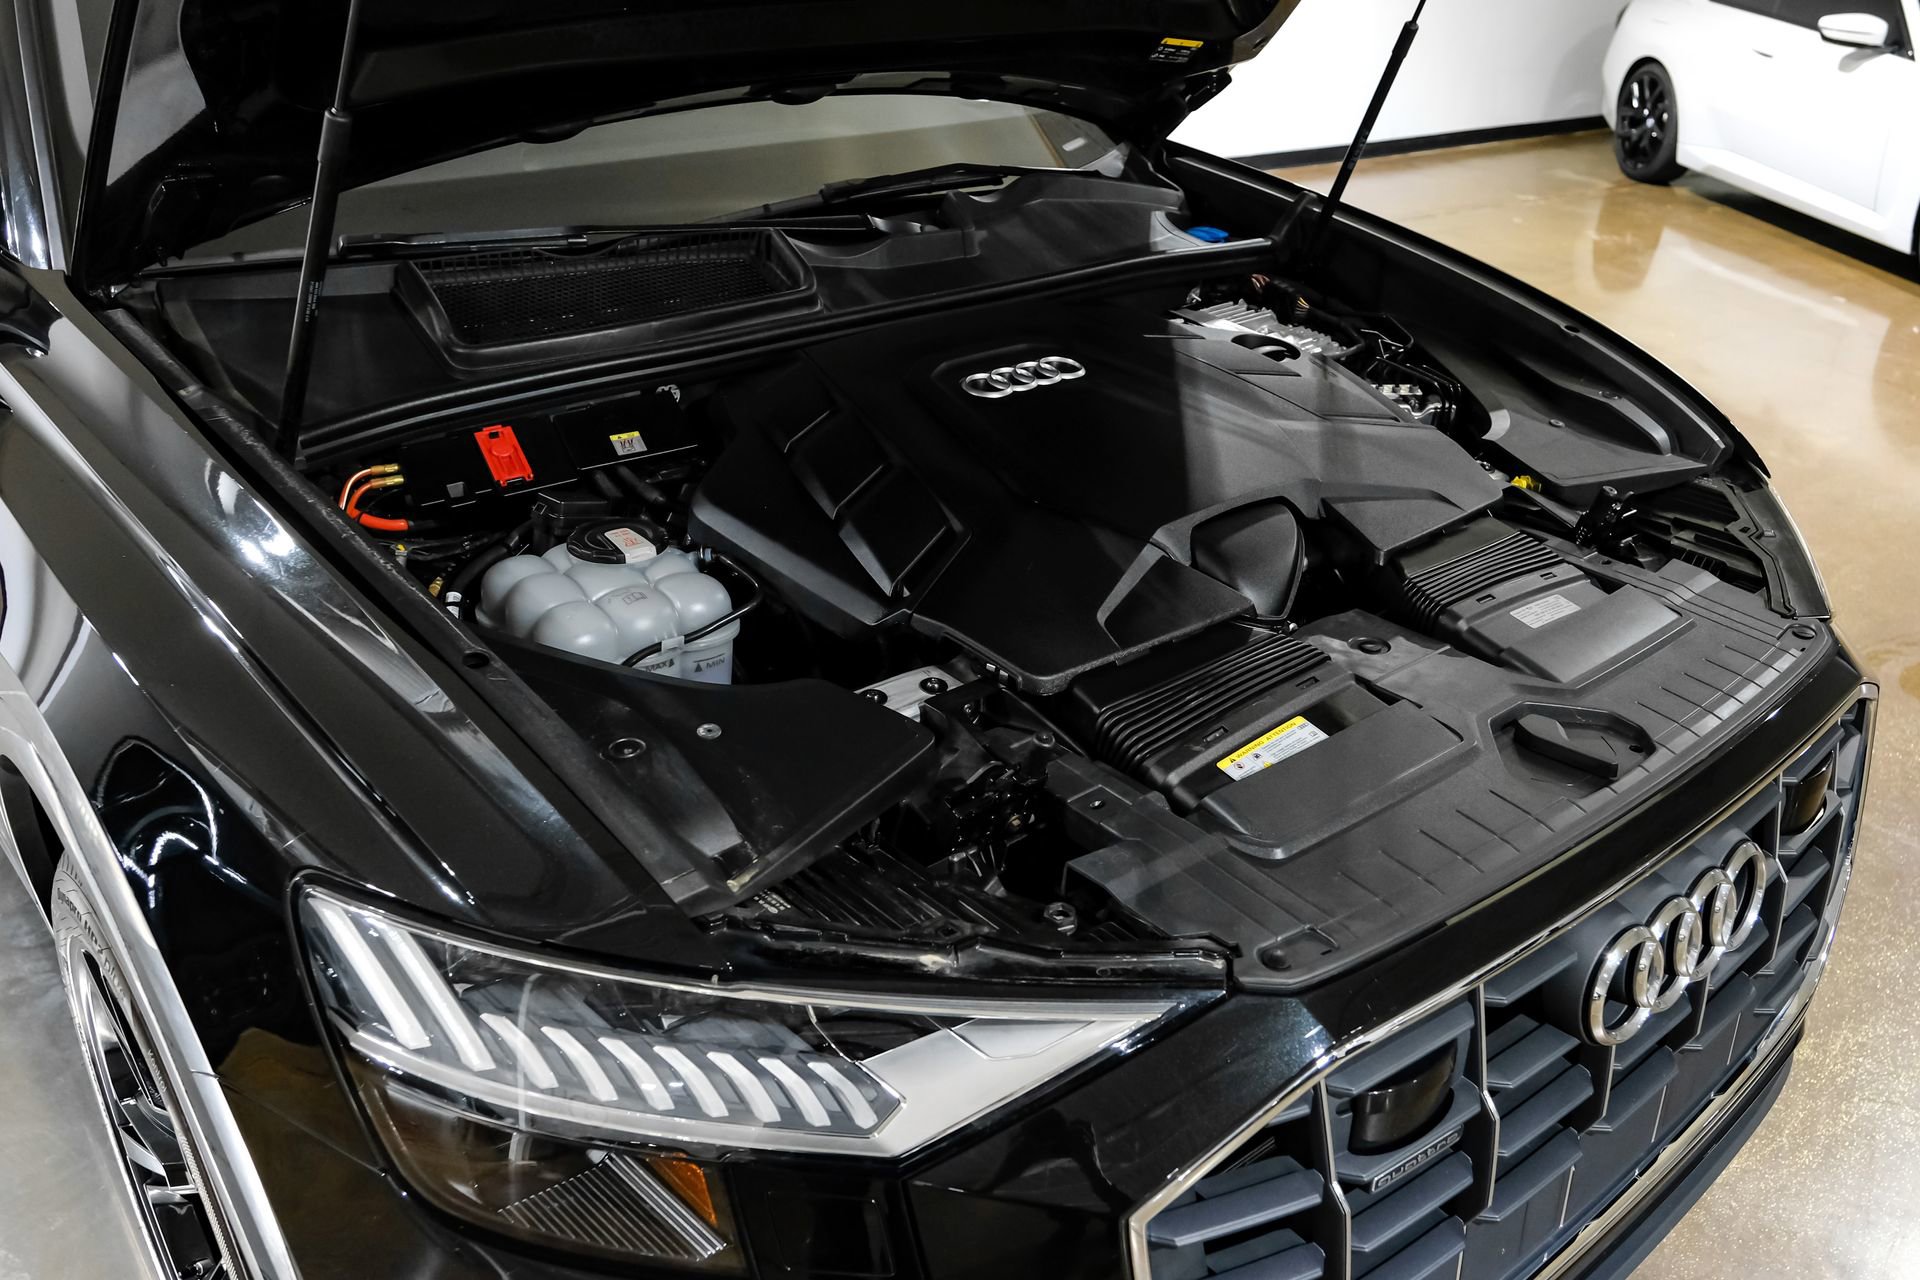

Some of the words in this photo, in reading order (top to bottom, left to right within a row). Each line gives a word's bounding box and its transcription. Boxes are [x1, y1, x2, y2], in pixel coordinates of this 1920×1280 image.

[706, 656, 726, 669] MIN
[1235, 739, 1265, 760] WARNING
[1266, 721, 1297, 742] ATTENTION
[1377, 1132, 1458, 1187] quattro
